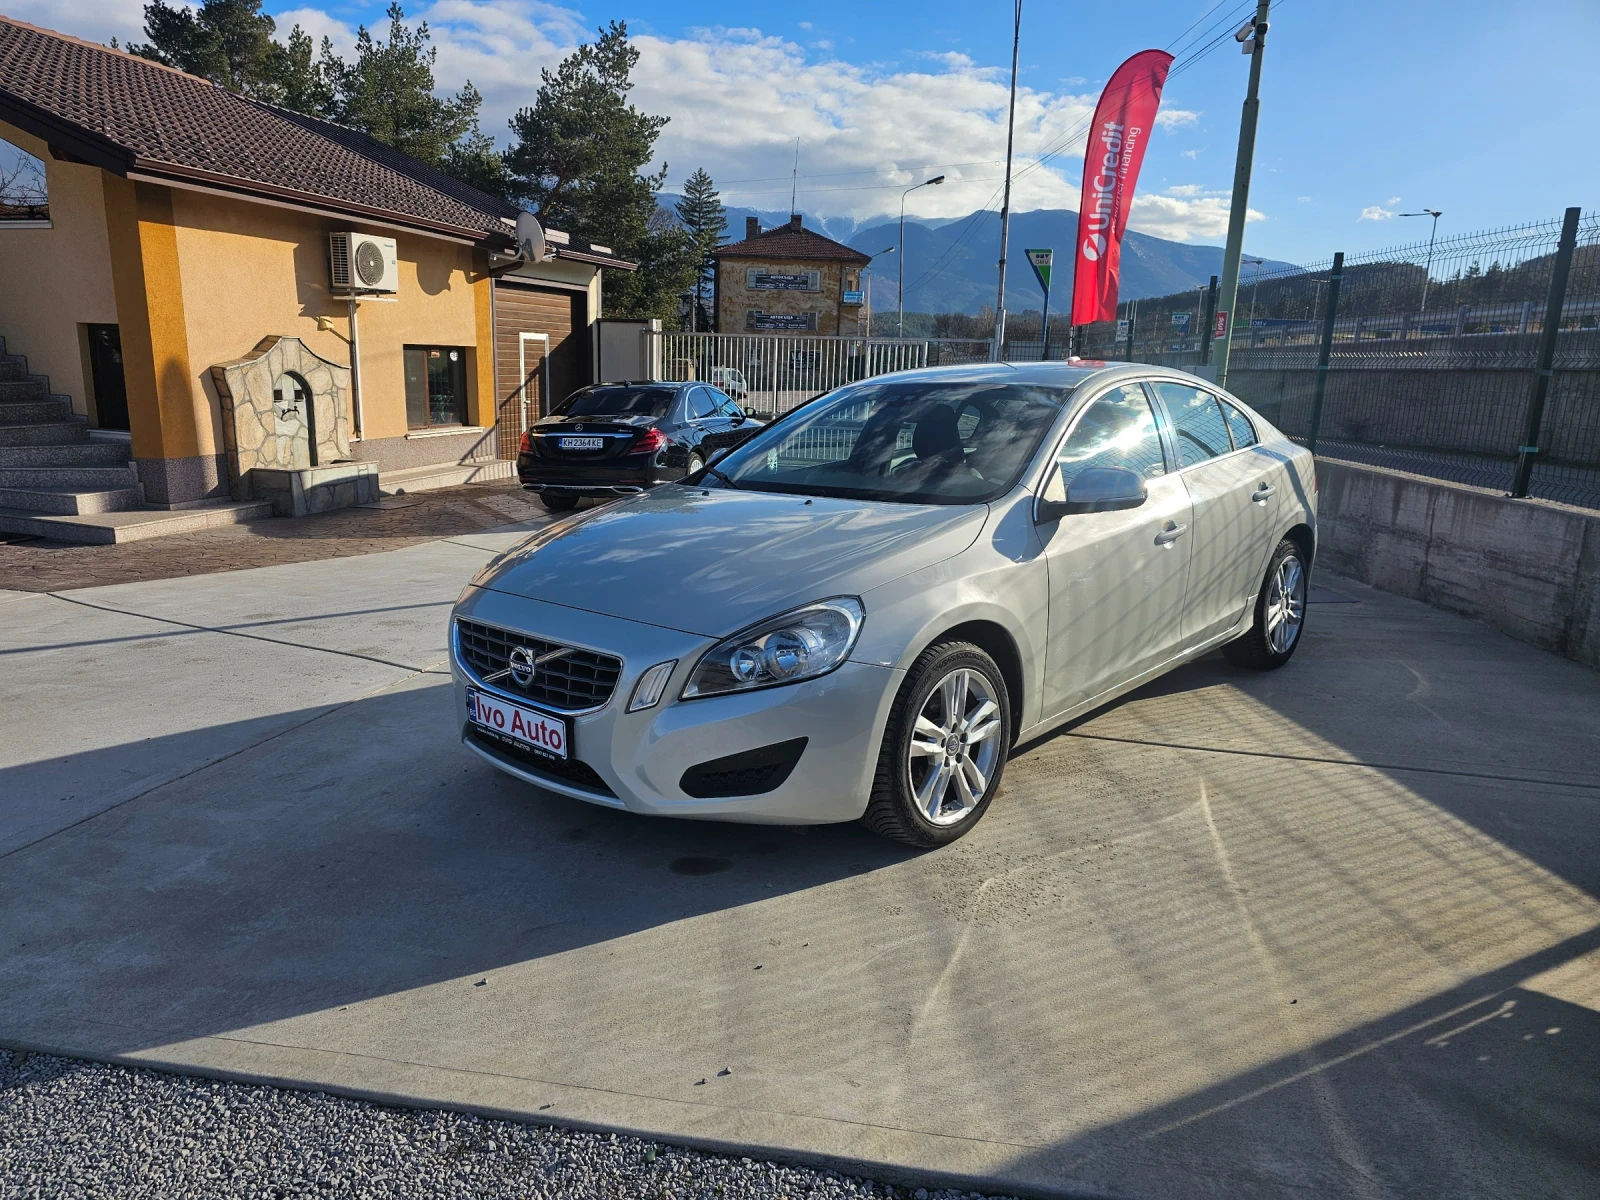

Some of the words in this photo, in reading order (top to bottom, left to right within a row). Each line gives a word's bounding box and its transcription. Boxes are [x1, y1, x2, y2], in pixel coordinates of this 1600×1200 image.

[1087, 121, 1125, 231] UniCredit
[510, 661, 531, 673] VOLVO
[475, 696, 505, 729] Ivo
[511, 709, 563, 751] Auto
